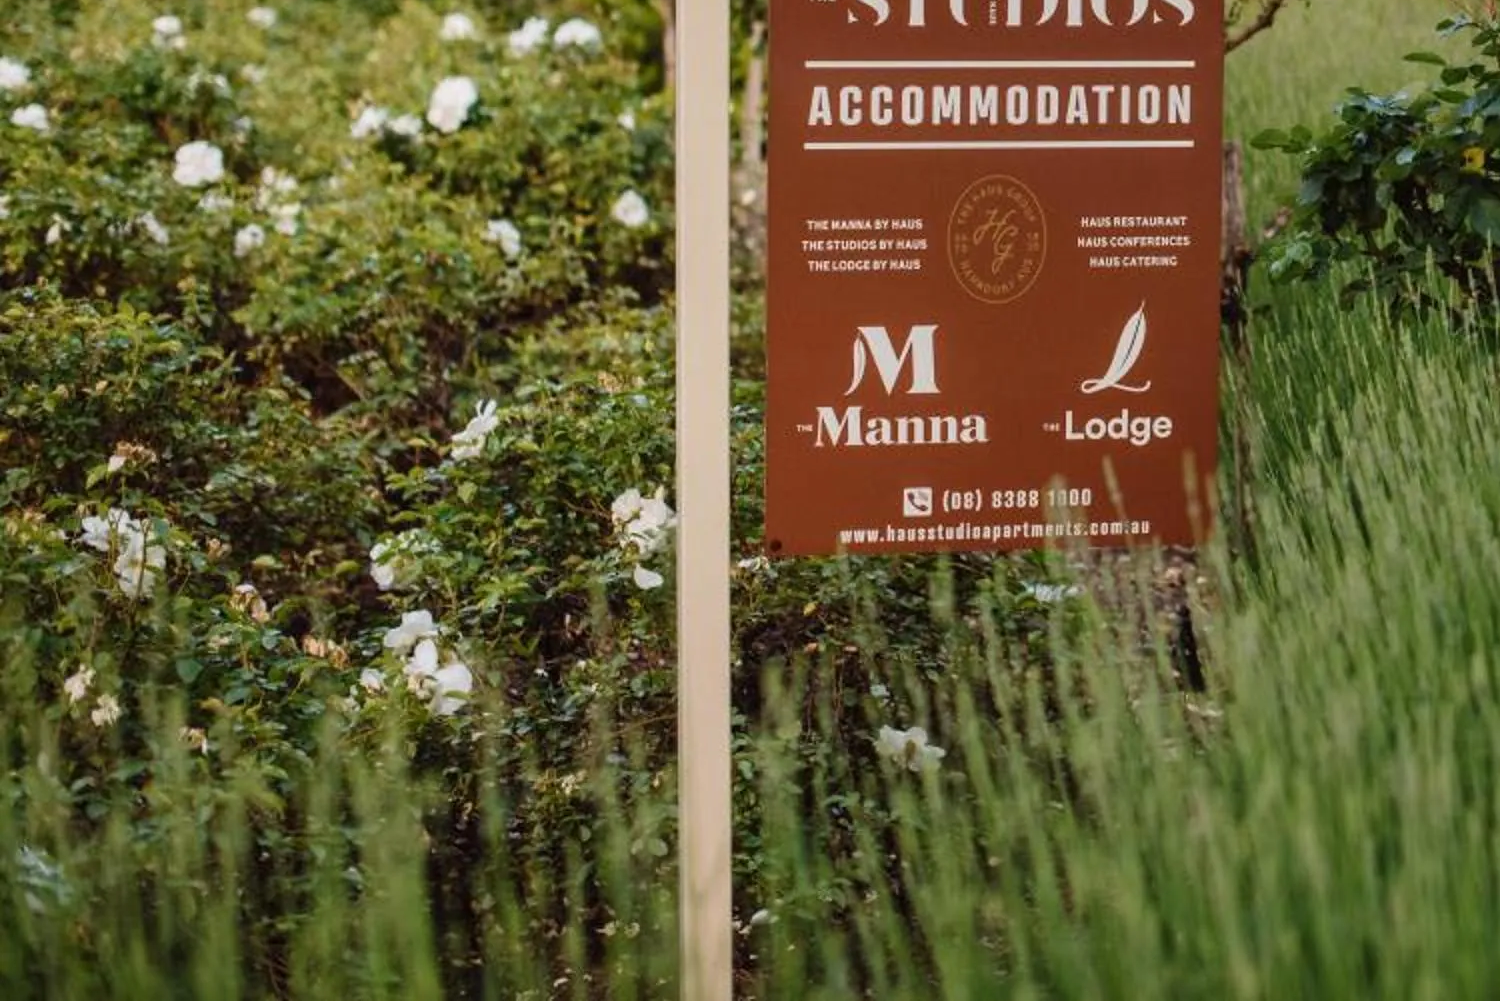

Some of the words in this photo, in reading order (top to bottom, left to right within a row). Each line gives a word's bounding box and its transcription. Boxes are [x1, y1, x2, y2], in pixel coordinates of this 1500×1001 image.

[807, 84, 1192, 127] ACCOMMODATION
[806, 219, 829, 231] THE
[831, 219, 872, 230] MANNA
[874, 218, 889, 230] BY
[891, 218, 923, 230] HAUS
[1081, 216, 1111, 228] HAUS
[1113, 215, 1188, 227] RESTAURANT
[801, 240, 825, 251] THE
[826, 240, 877, 251] STUDIOS
[879, 239, 894, 250] BY
[895, 238, 928, 250] HAUS
[1077, 236, 1108, 248] HAUS
[1109, 235, 1191, 247] CONFERENCES
[808, 260, 830, 271] THE
[831, 260, 870, 271] LODGE
[872, 259, 887, 270] BY
[888, 258, 921, 270] HAUS
[1089, 256, 1120, 268] HAUS
[1121, 256, 1178, 267] CATERING
[844, 324, 941, 396] M
[796, 423, 813, 433] THE
[814, 406, 989, 448] Manna
[1065, 408, 1173, 446] Lodge
[943, 489, 982, 512] (08)
[991, 489, 1040, 509] 8388
